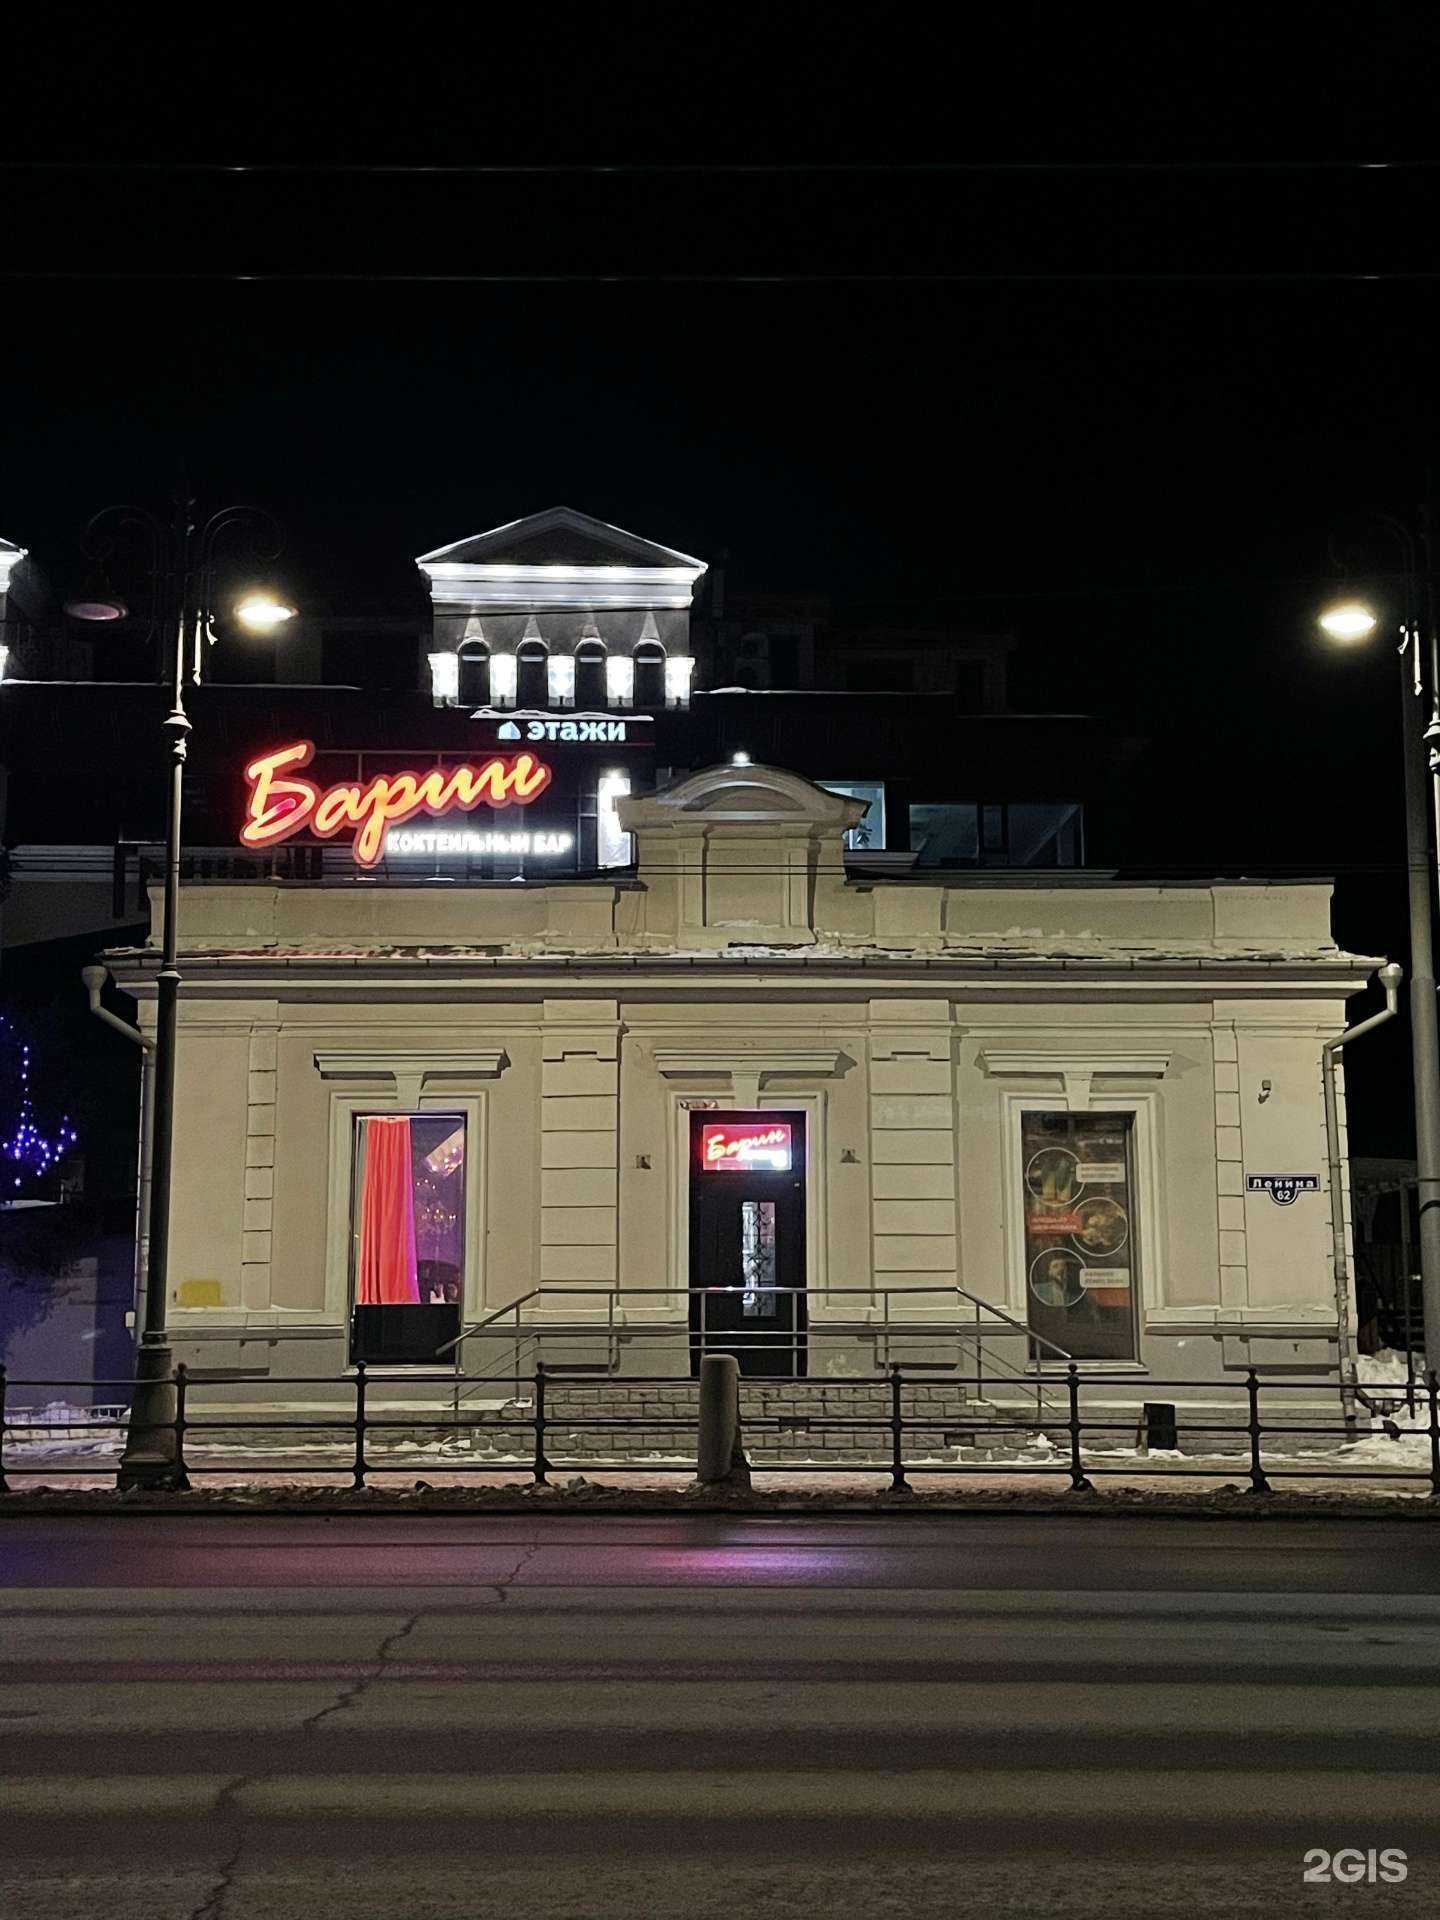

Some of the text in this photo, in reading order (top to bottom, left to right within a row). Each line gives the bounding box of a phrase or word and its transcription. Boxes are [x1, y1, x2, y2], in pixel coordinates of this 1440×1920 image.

[527, 720, 626, 741] этажи
[240, 740, 551, 867] Барин
[533, 831, 573, 854] БАР
[1252, 1178, 1315, 1189] Ленина
[1276, 1190, 1292, 1201] 62
